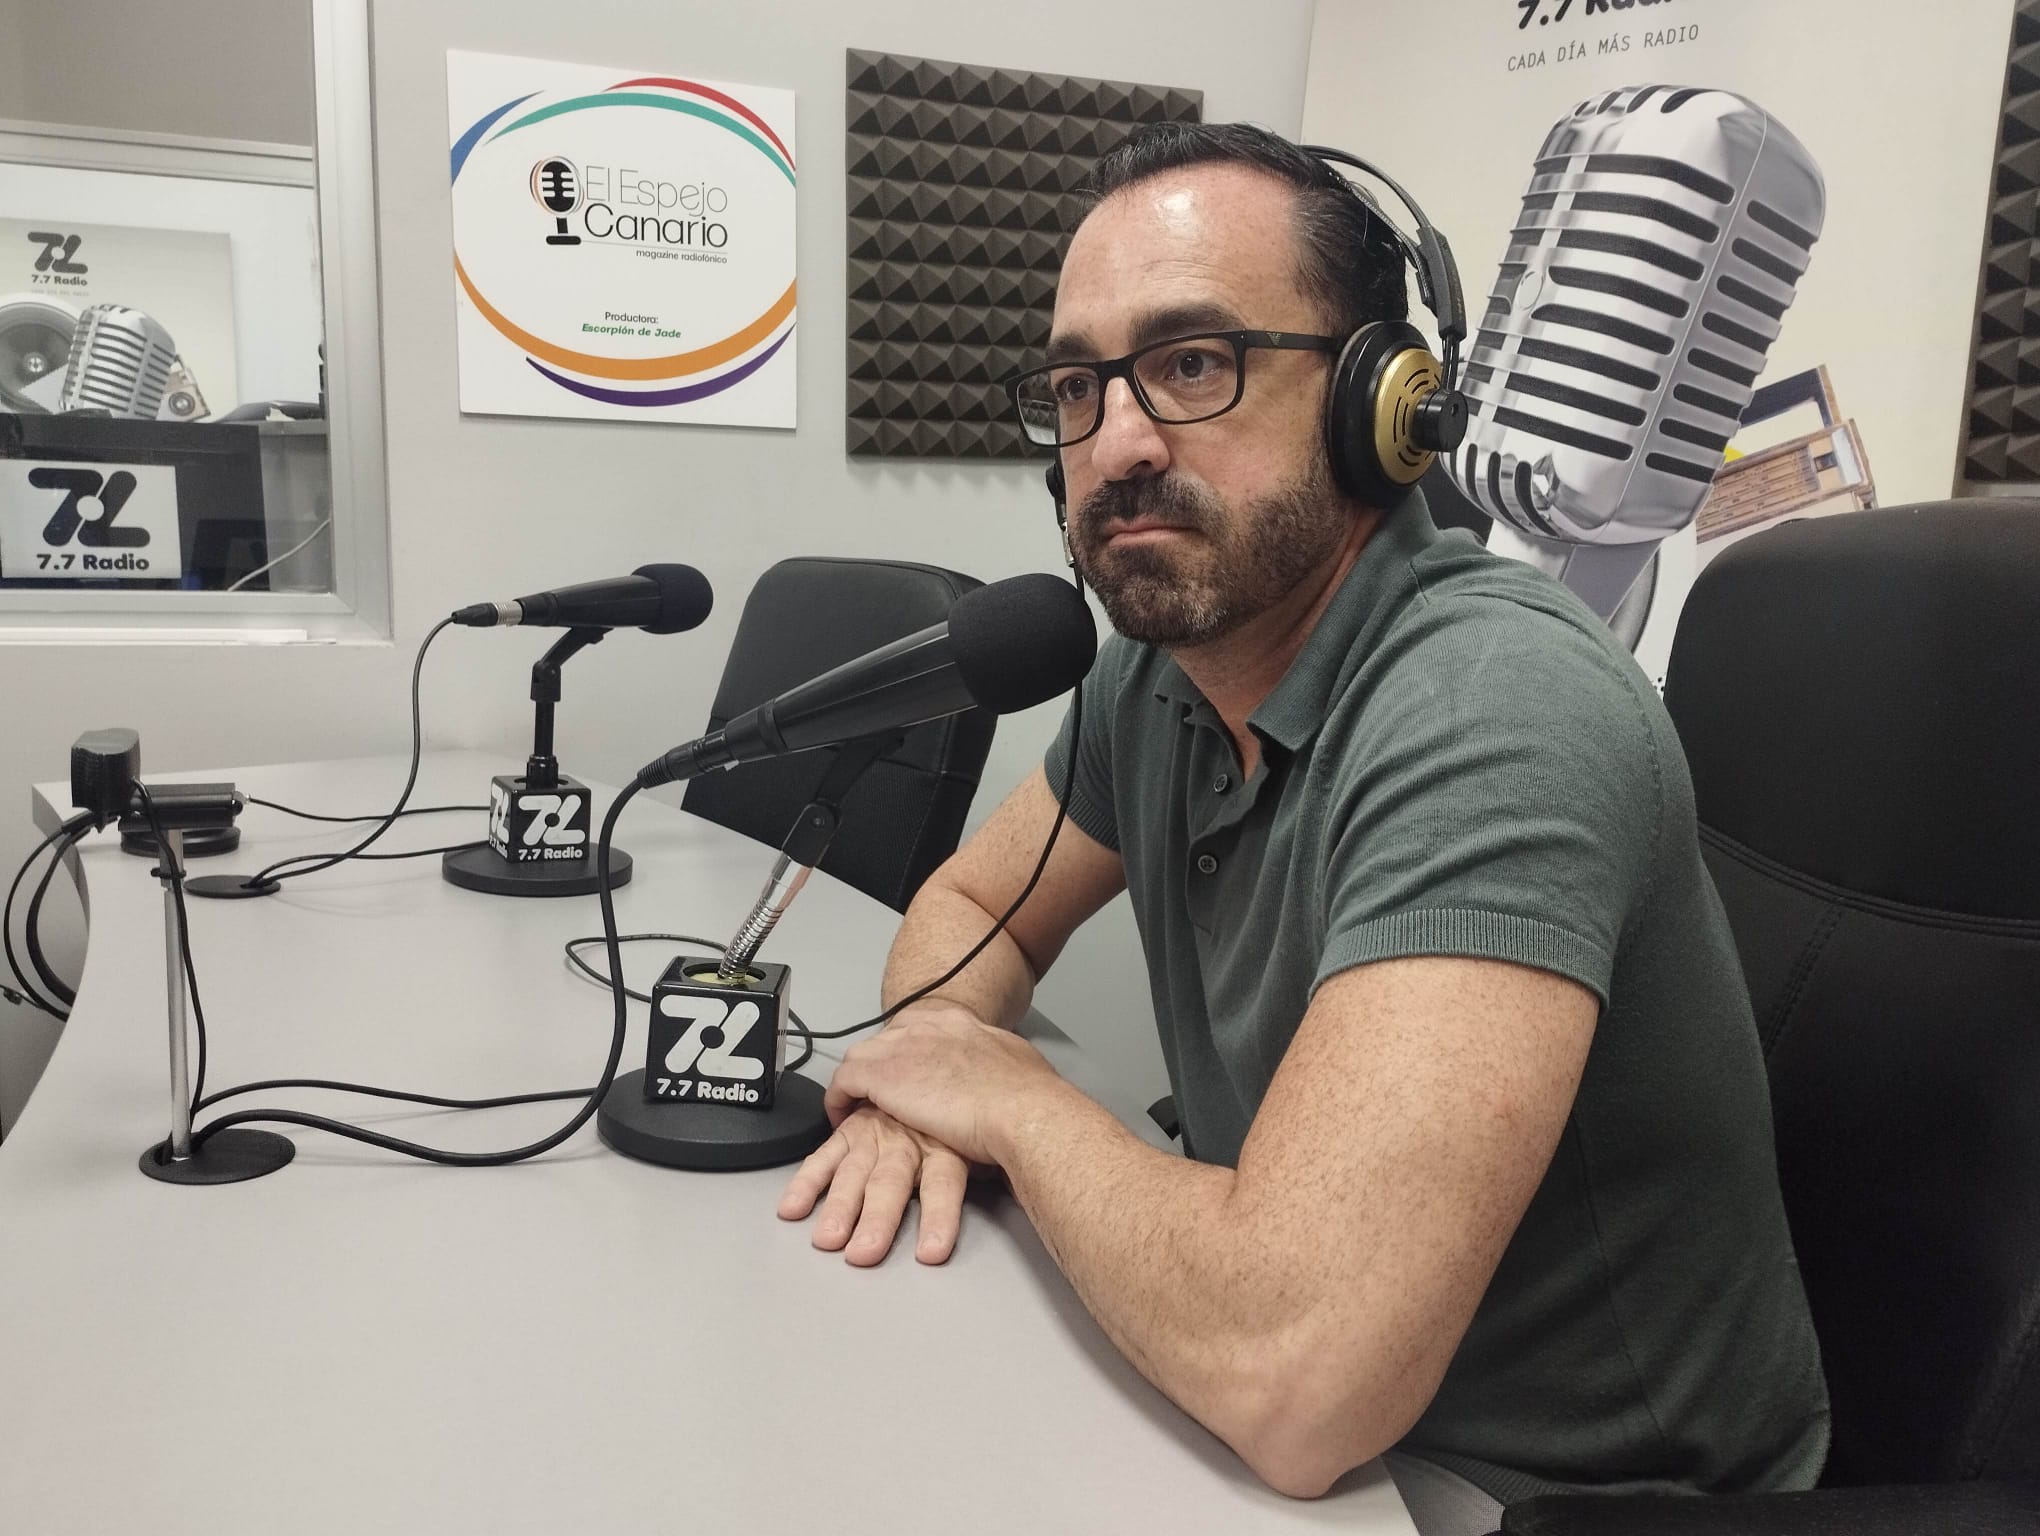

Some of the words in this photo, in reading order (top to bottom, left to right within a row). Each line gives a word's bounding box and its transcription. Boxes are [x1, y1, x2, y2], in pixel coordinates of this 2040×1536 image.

[1507, 51, 1546, 72] CADA
[1557, 41, 1586, 63] DÍA
[1598, 33, 1630, 55] MÁS
[1644, 24, 1699, 48] RADIO
[586, 165, 610, 202] El
[620, 168, 728, 217] Espejo
[584, 203, 728, 248] Canario
[636, 249, 679, 260] magazine
[681, 252, 728, 264] radiofónico
[31, 274, 51, 284] 7.7
[54, 276, 88, 287] Radio
[604, 311, 659, 324] Productora:
[582, 323, 635, 336] Escorpión
[638, 327, 652, 336] de
[655, 328, 682, 338] Jade
[36, 554, 76, 570] 7.7
[83, 553, 150, 570] Radio
[518, 849, 541, 860] 7.7
[544, 846, 583, 859] Radio
[656, 1078, 693, 1097] 7.7
[697, 1082, 759, 1103] Radio
